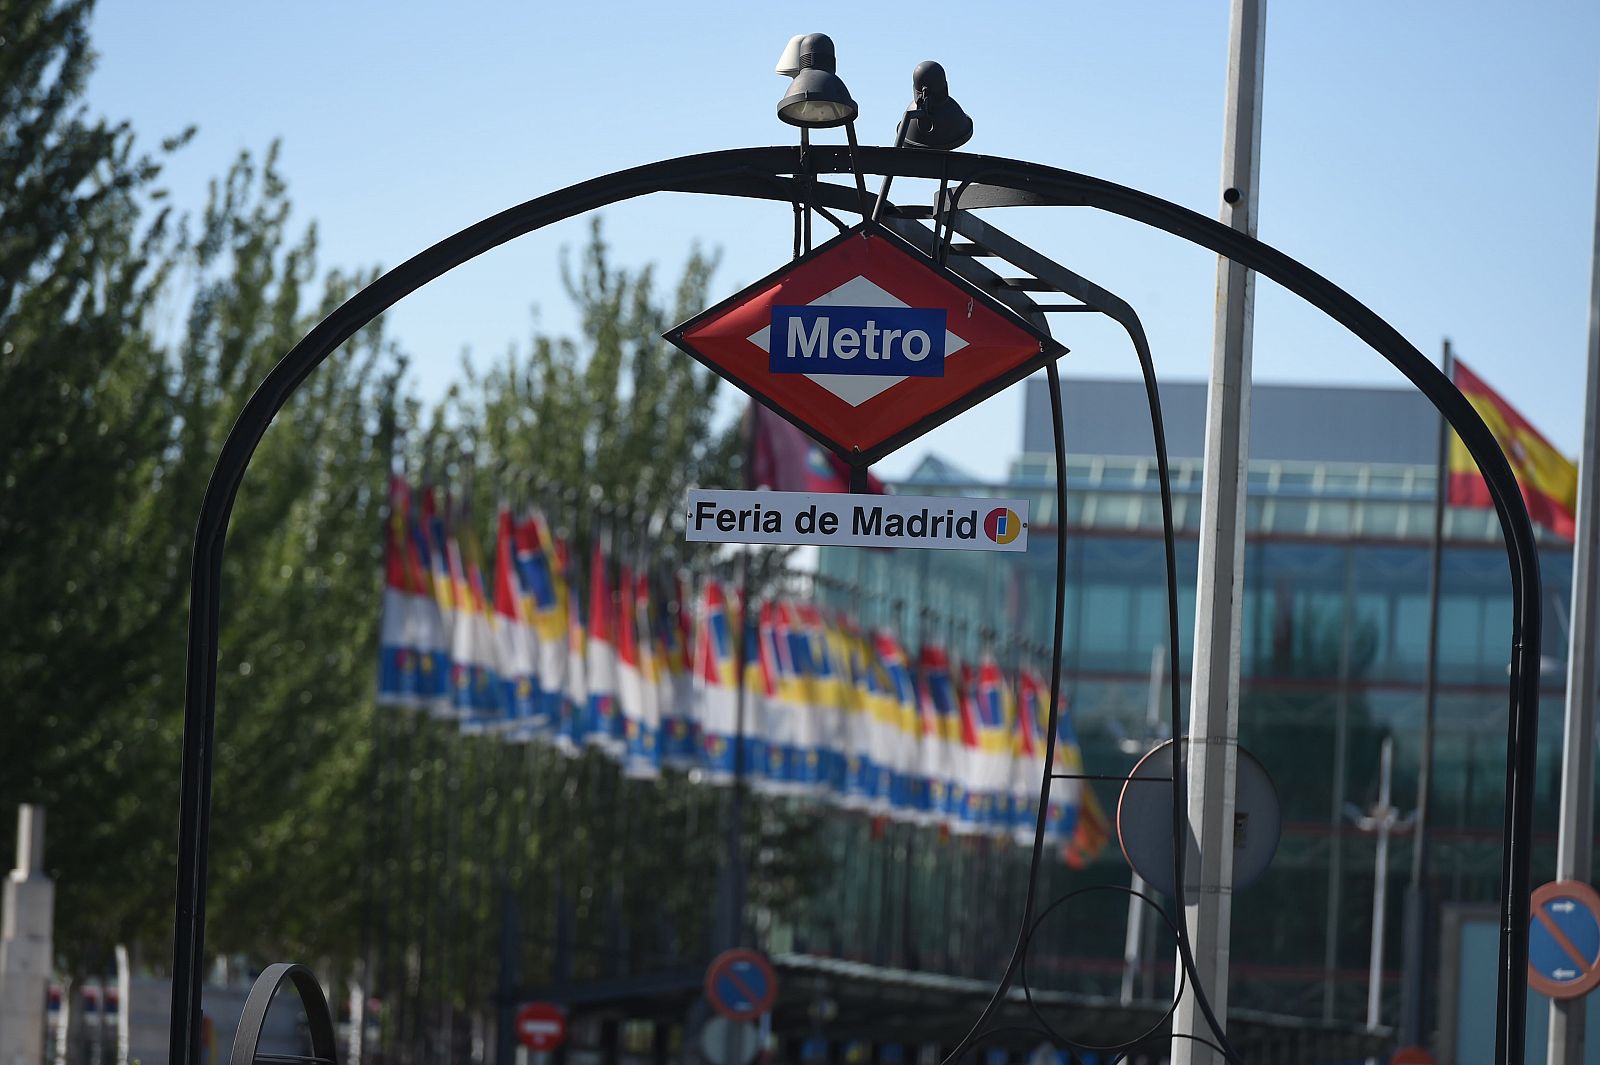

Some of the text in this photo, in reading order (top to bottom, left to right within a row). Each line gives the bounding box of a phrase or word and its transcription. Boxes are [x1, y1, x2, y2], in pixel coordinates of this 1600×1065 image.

[786, 316, 931, 361] Metro
[694, 501, 977, 540] Feria de Madrid
